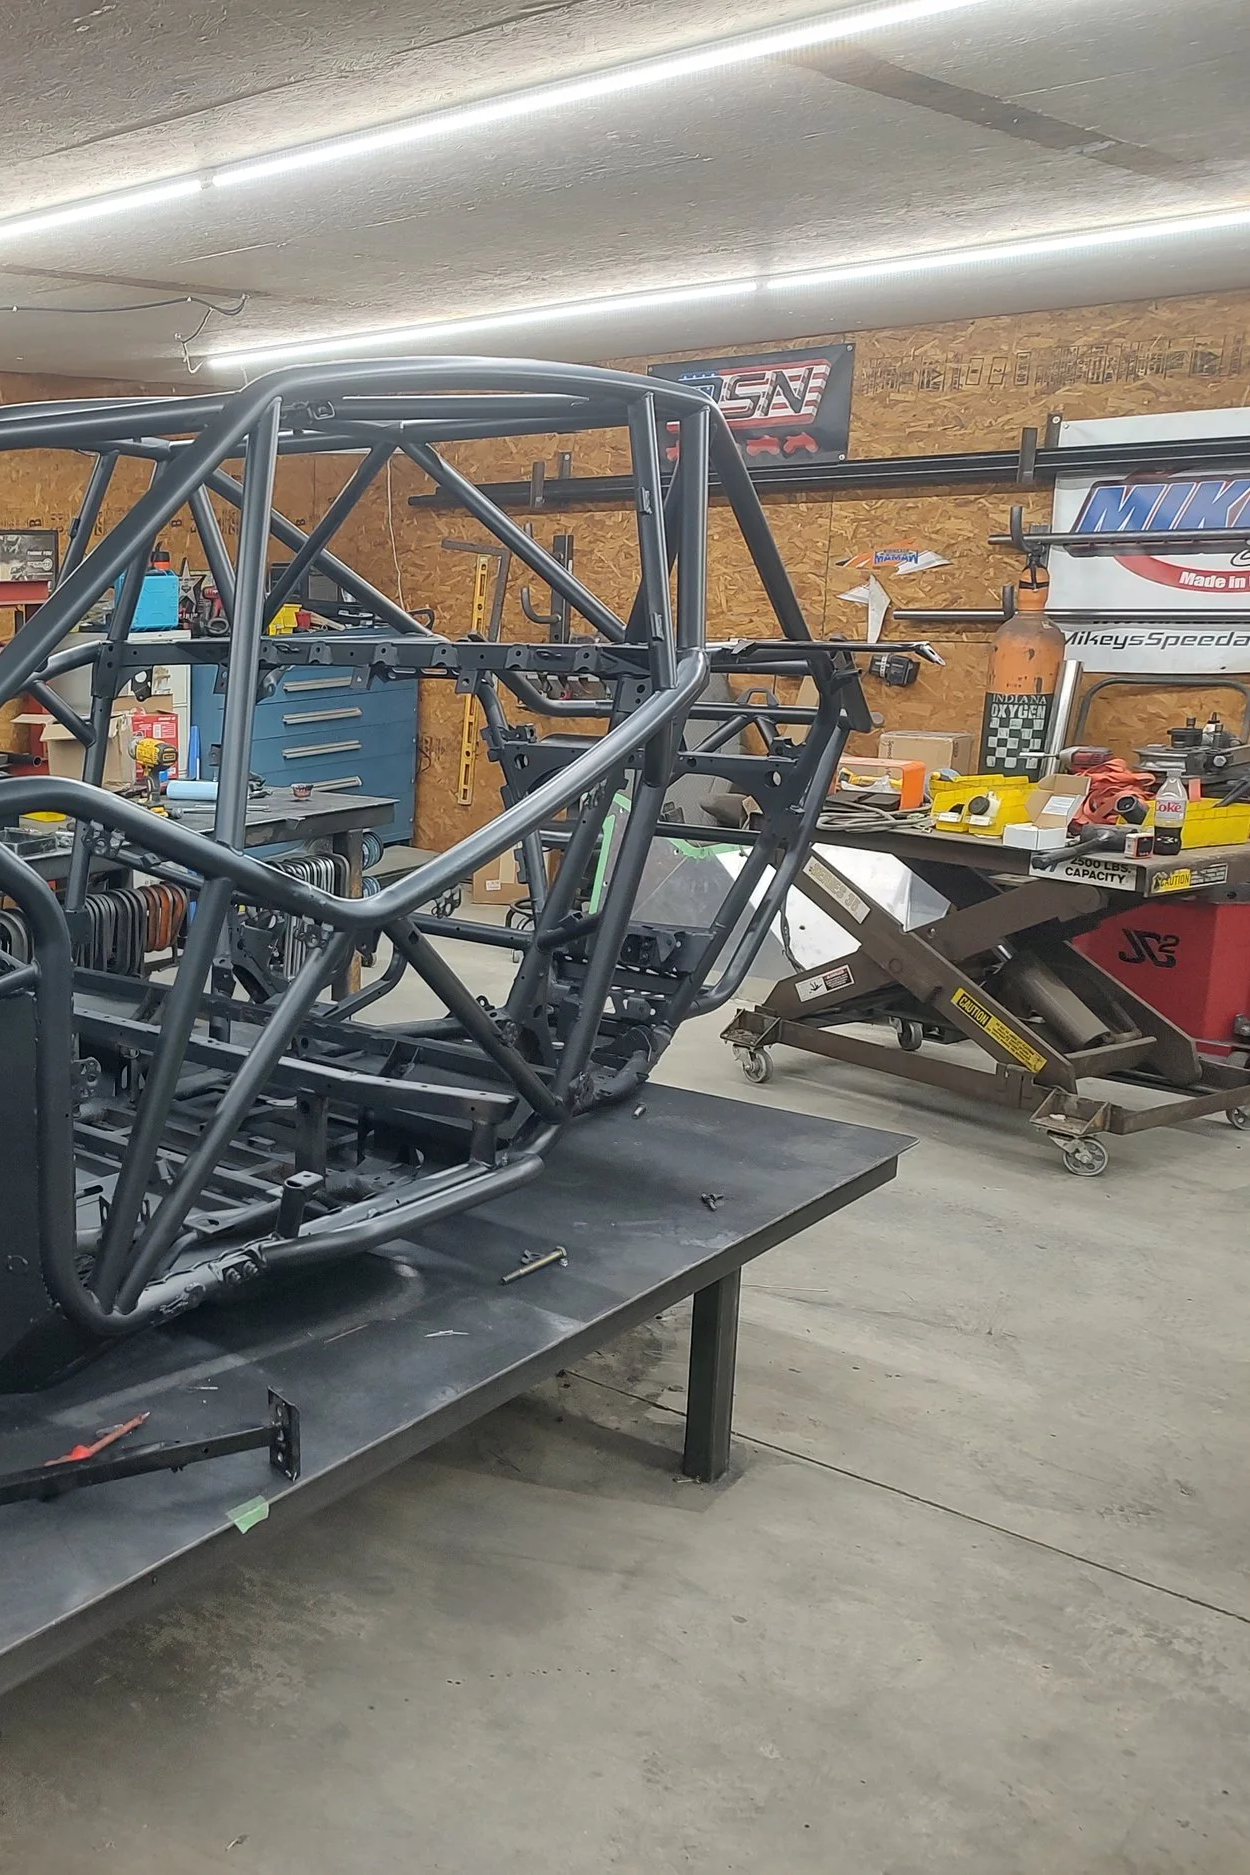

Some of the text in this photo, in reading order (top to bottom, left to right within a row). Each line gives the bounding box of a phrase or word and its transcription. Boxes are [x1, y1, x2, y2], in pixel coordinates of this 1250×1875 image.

[1178, 571, 1246, 589] Made in
[992, 694, 1047, 704] INDIANA
[991, 704, 1046, 718] OXYGEN
[1070, 857, 1132, 874] 2500 LBS.
[1065, 866, 1126, 884] CAPACITY
[1160, 872, 1190, 888] CAUTION
[958, 994, 990, 1026] CAUTION
